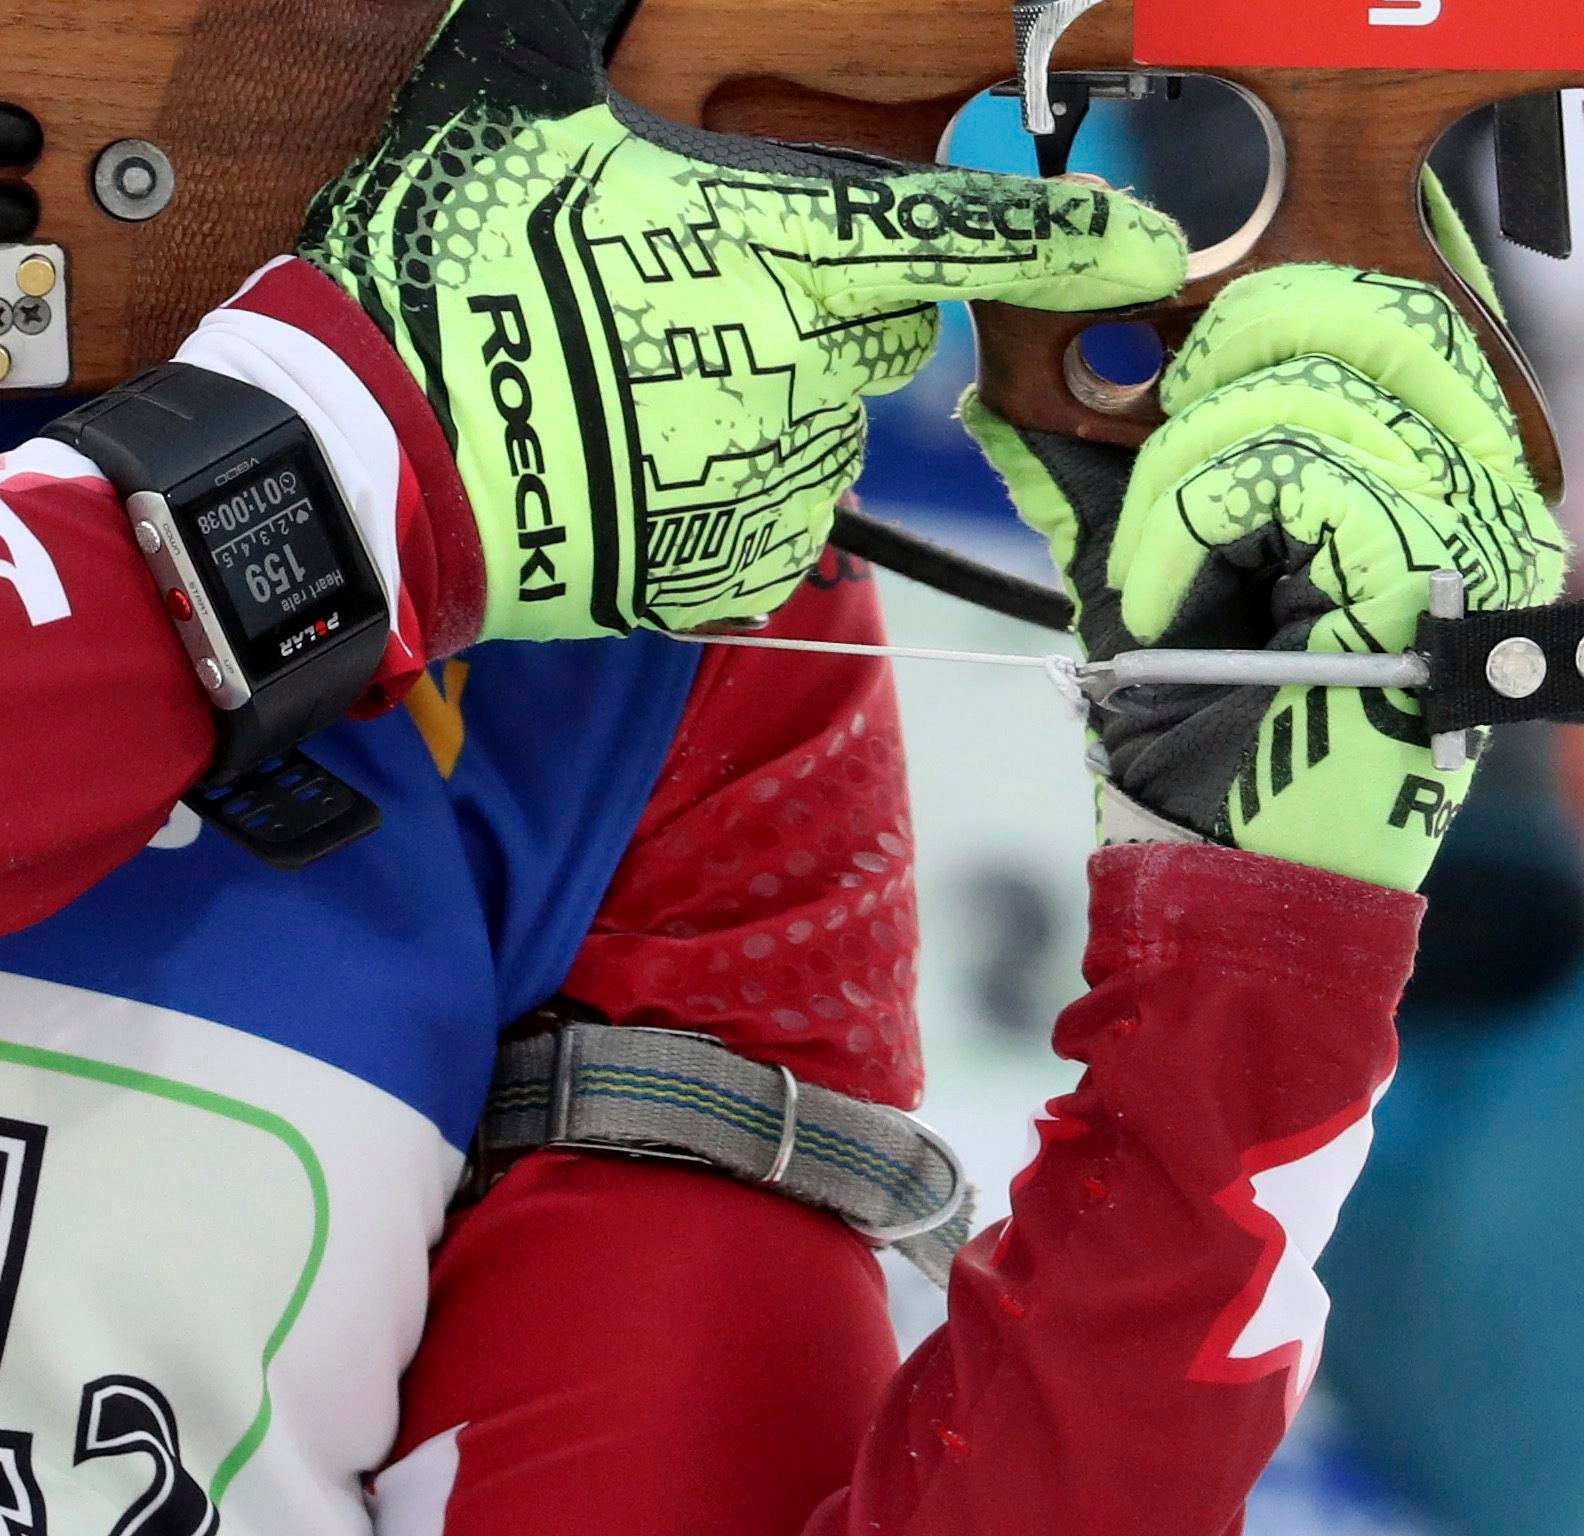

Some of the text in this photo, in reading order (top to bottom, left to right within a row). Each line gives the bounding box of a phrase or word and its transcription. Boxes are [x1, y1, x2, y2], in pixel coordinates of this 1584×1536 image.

[244, 542, 307, 604] 159
[311, 568, 345, 596] Heart
[278, 611, 341, 658] POLAR
